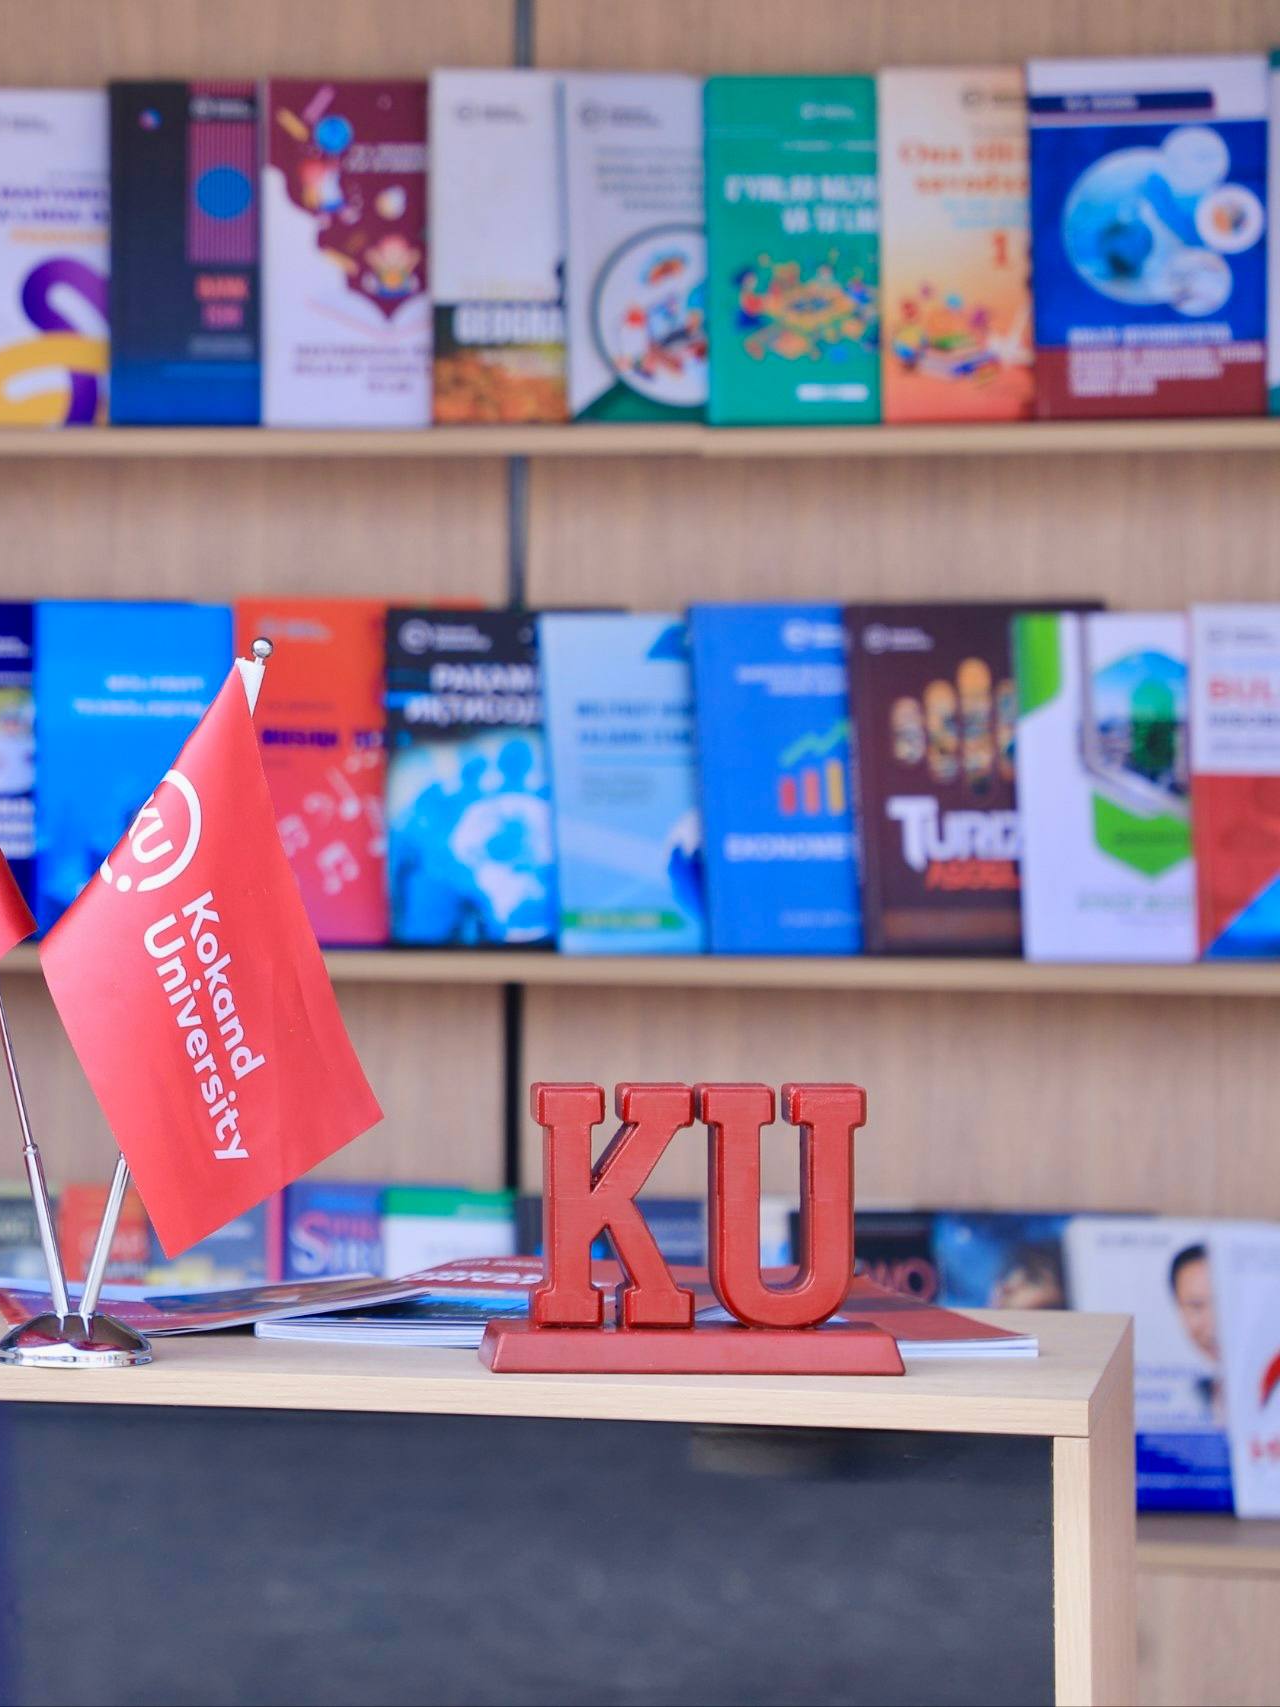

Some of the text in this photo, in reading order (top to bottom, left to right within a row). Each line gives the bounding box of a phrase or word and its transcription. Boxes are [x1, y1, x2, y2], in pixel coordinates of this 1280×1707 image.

[143, 912, 250, 1160] University
[181, 890, 266, 1081] Kokand
[530, 1081, 867, 1330] KU
